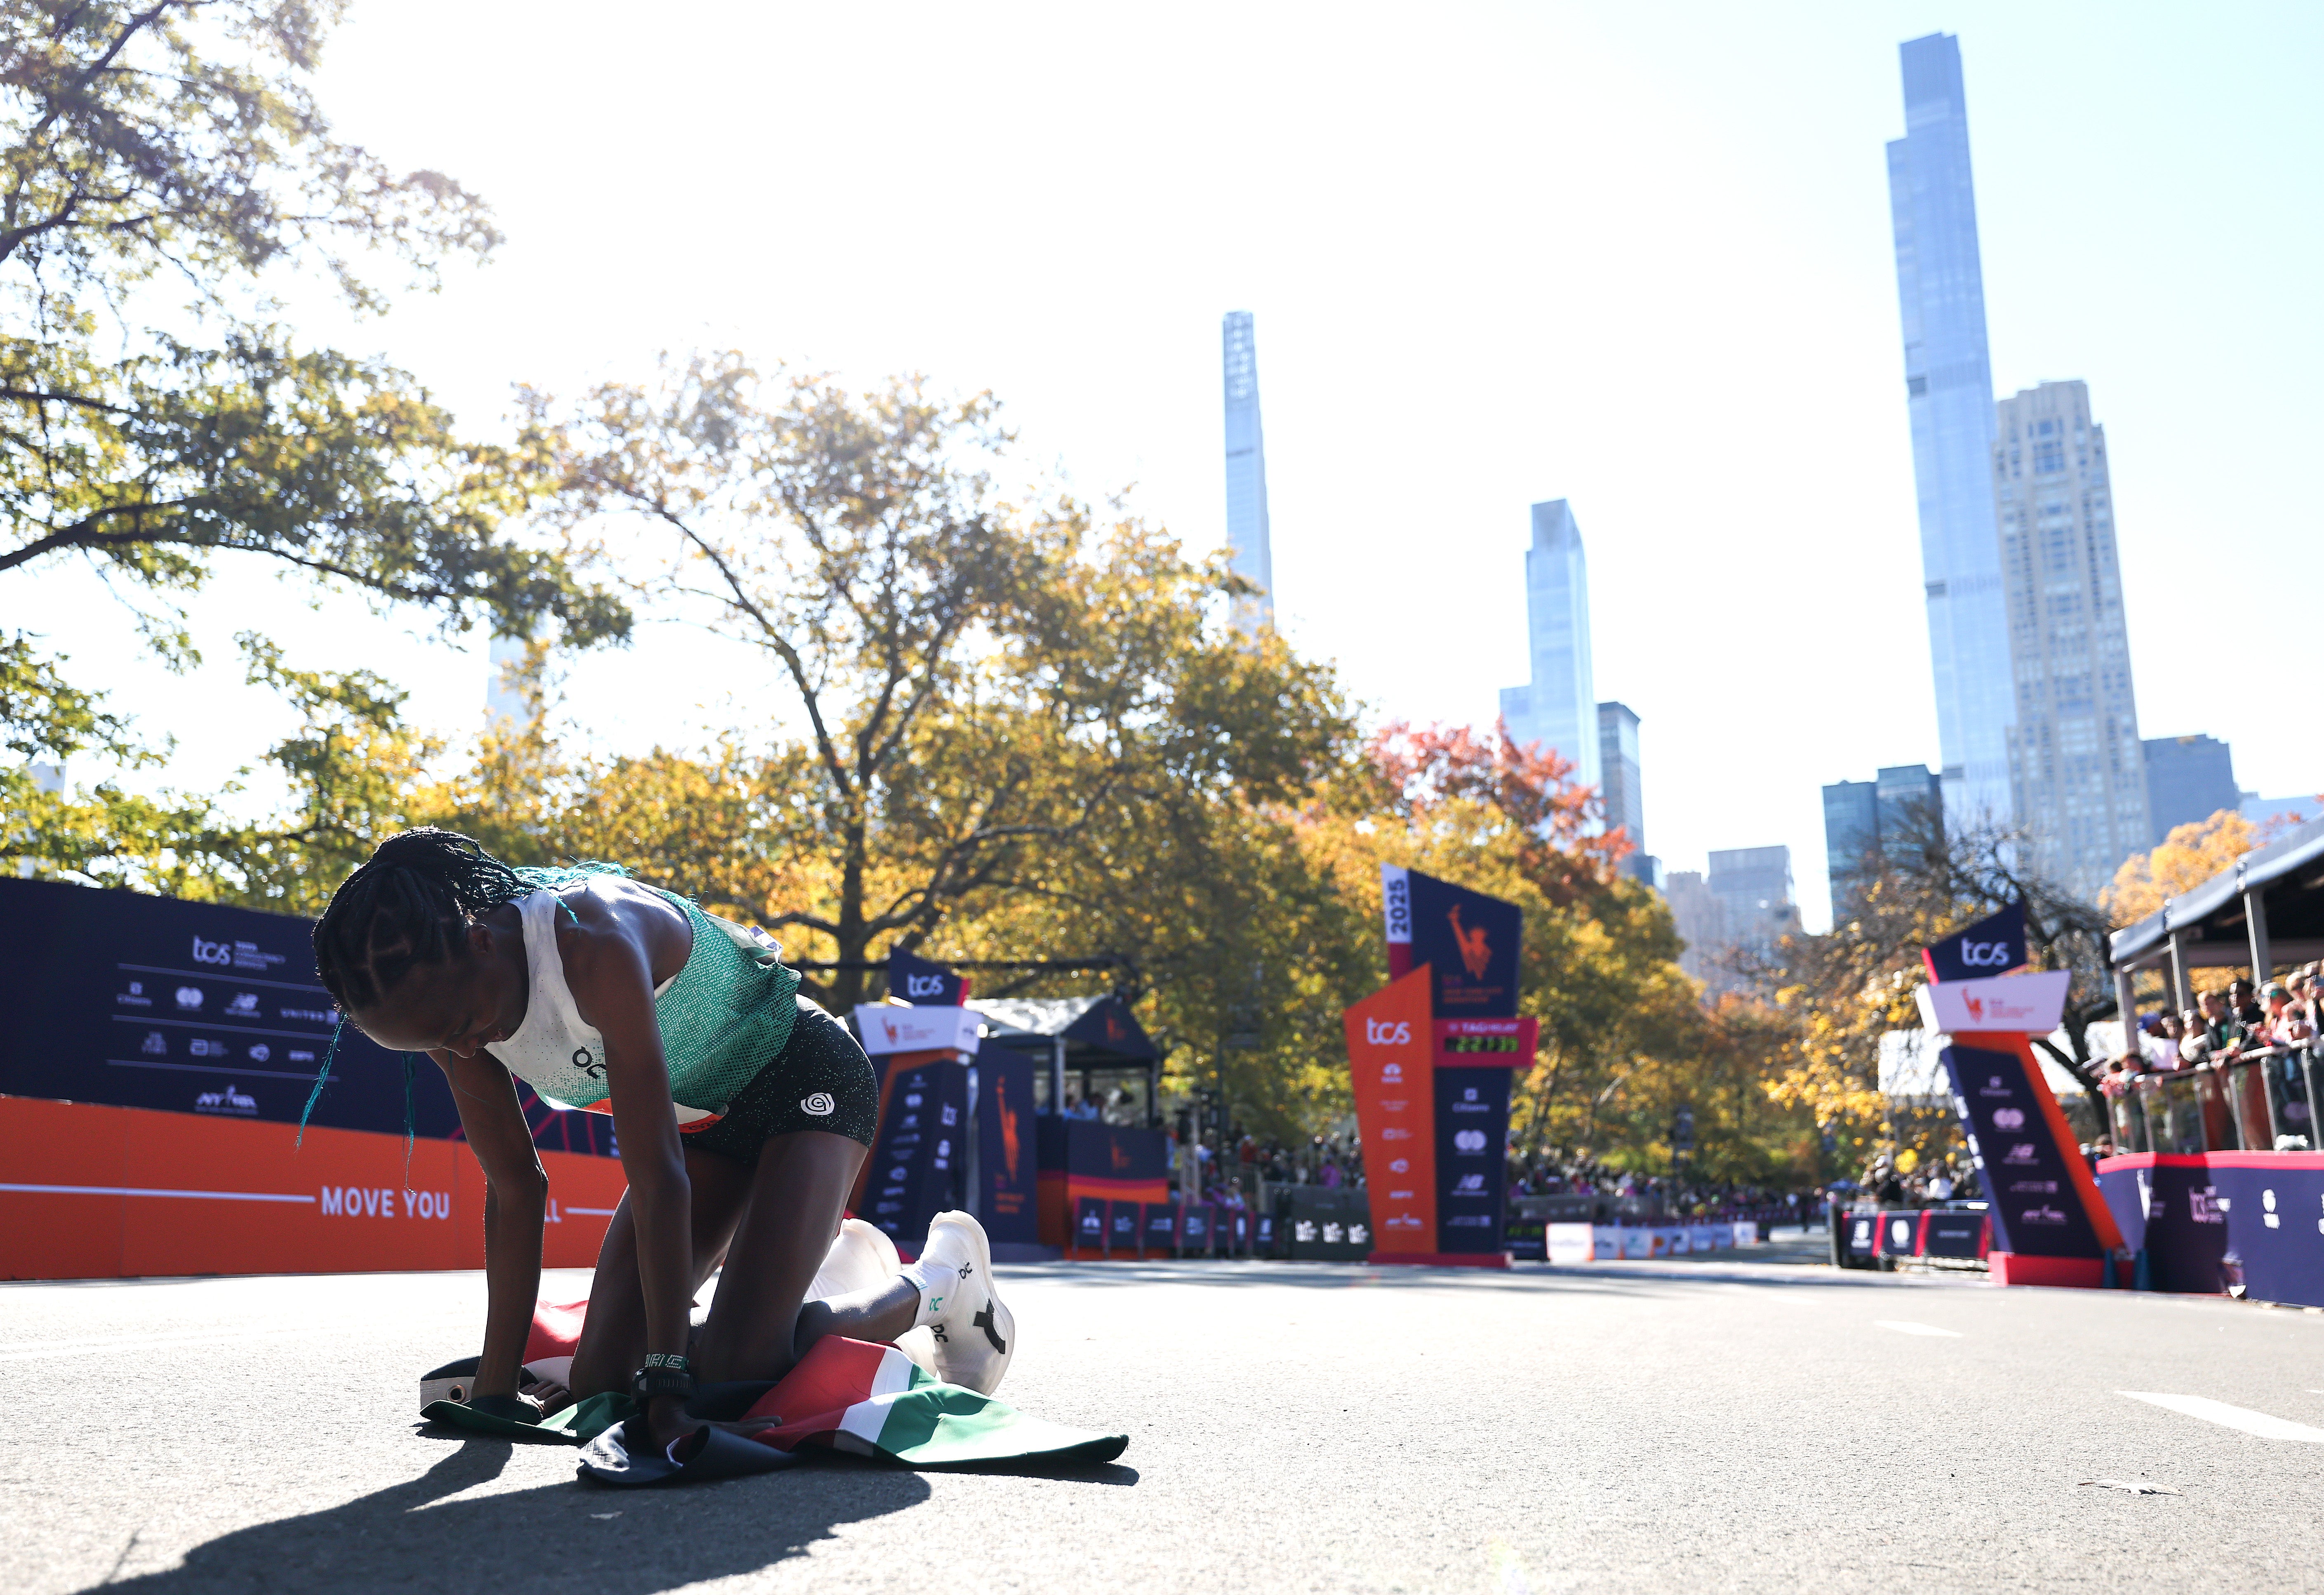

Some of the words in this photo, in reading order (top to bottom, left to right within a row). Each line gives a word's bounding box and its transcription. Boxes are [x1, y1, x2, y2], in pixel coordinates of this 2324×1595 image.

[1389, 880, 1407, 935] 2025
[193, 934, 231, 965] tcs
[1961, 936, 2009, 966] tcs
[908, 973, 944, 997] tcs
[1367, 1016, 1411, 1045] tcs
[321, 1186, 394, 1218] MOVE
[402, 1190, 449, 1219] YOU
